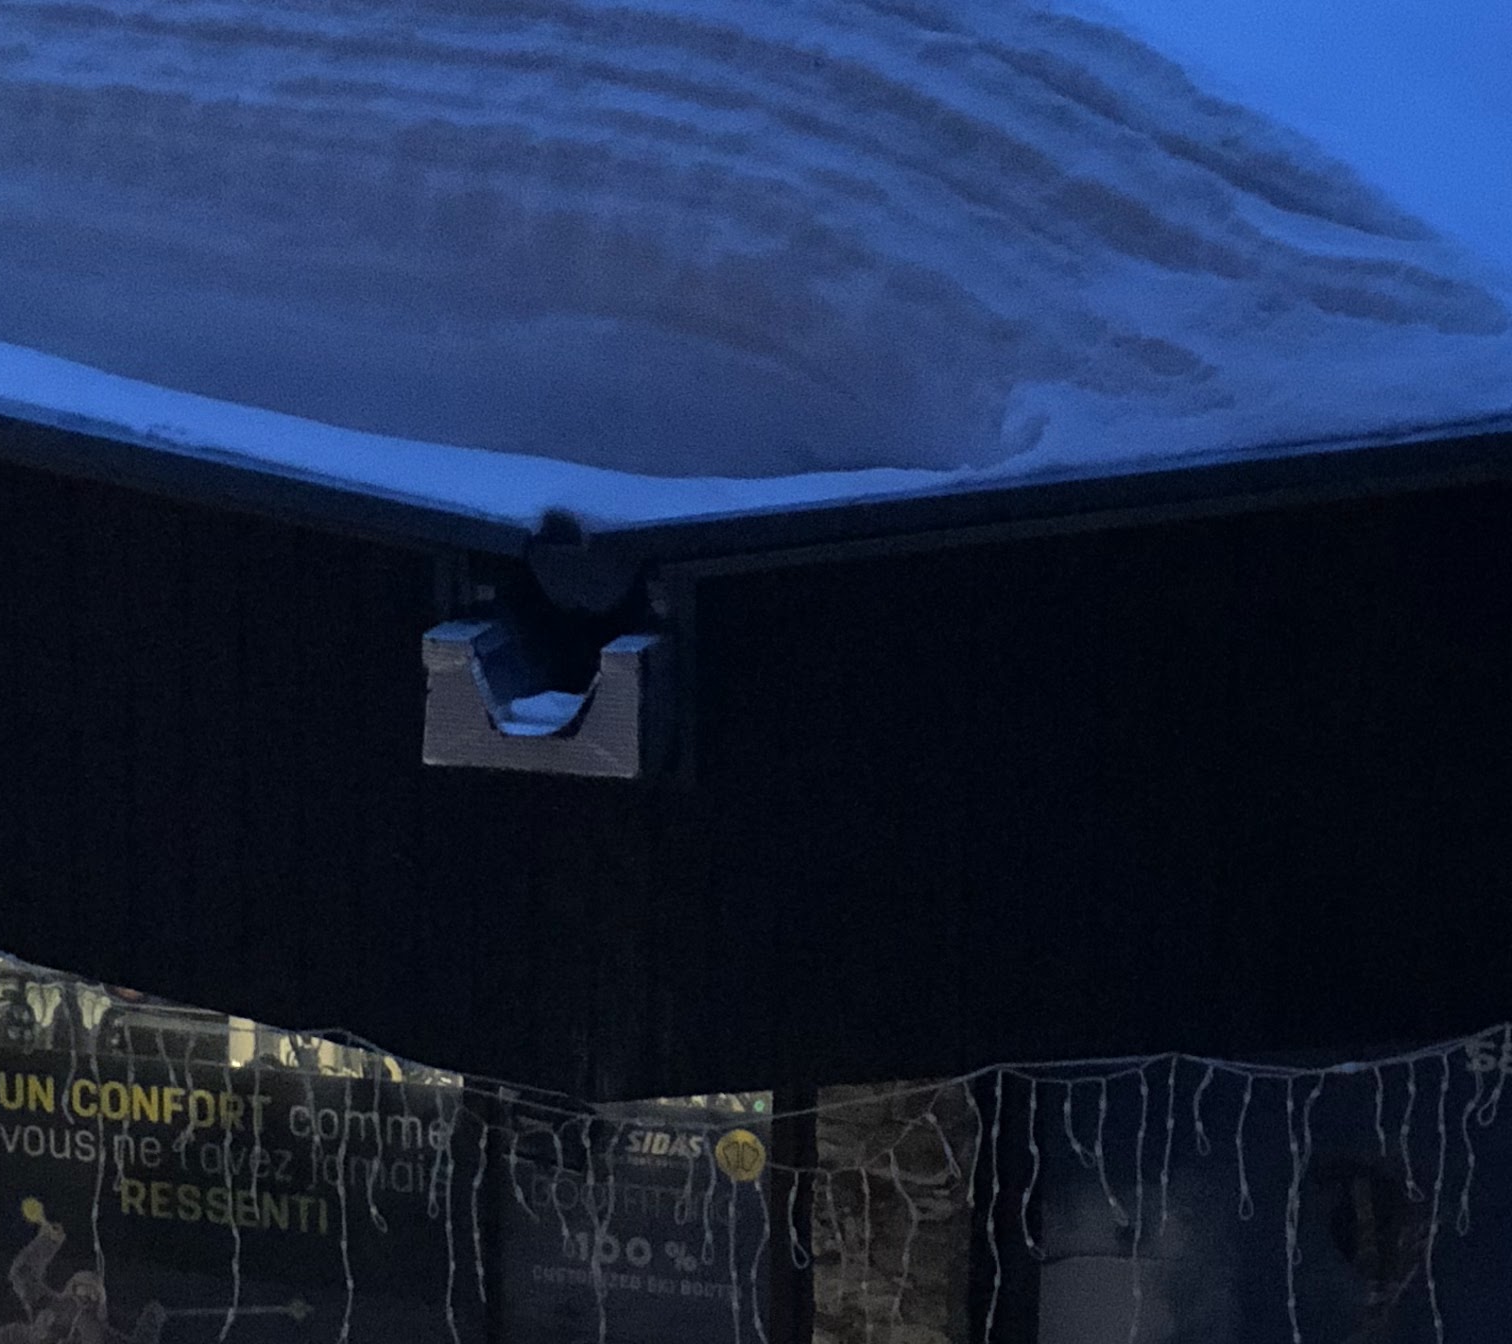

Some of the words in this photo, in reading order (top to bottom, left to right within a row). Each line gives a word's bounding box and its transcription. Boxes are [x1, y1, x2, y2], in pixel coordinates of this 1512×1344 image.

[71, 1078, 273, 1135] CONFORT
[289, 1101, 450, 1152] comme
[113, 1131, 162, 1170] ne
[625, 1130, 704, 1159] SIDAS
[119, 1177, 329, 1234] RESSENTI
[575, 1231, 652, 1268] 100
